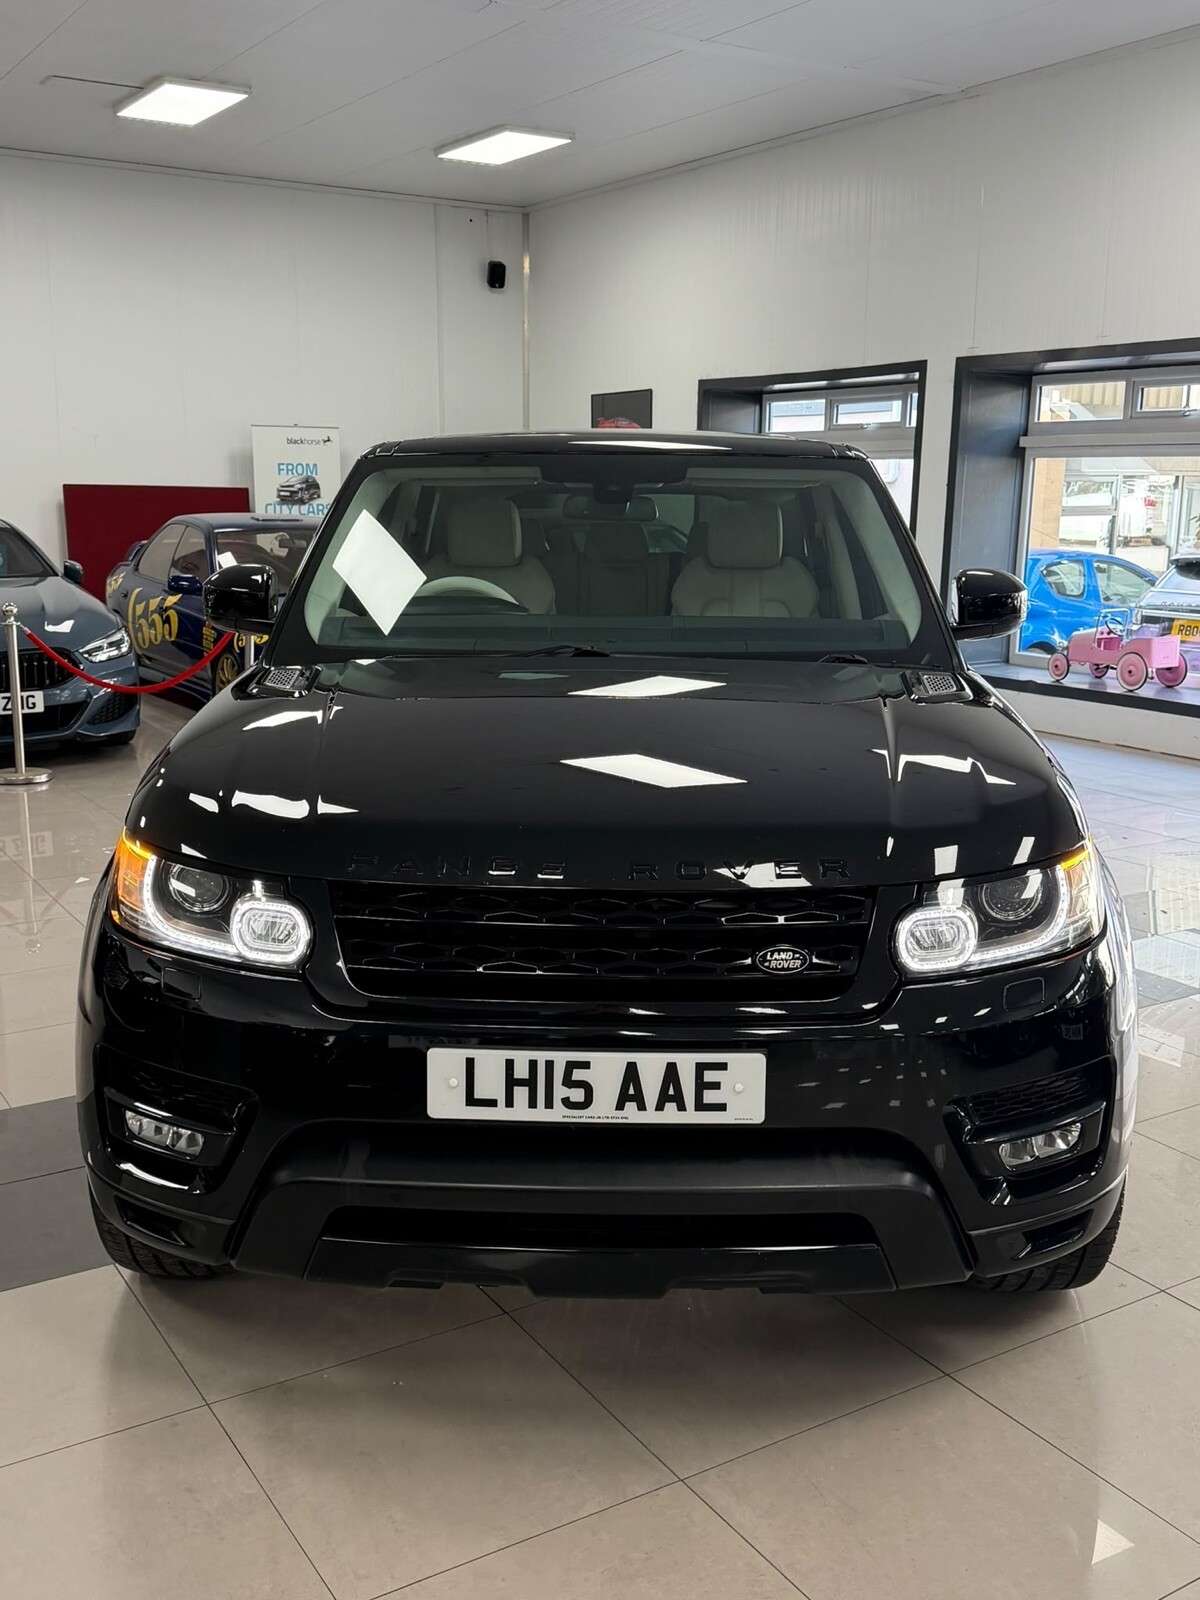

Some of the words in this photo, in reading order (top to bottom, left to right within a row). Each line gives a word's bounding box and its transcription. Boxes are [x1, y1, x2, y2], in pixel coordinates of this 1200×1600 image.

[286, 436, 321, 445] blackhorse
[277, 462, 318, 476] FROM
[264, 502, 295, 515] CITY
[627, 858, 853, 882] ROVER
[766, 951, 793, 960] LAND
[769, 959, 802, 969] ROVER
[465, 1057, 594, 1110] LH15
[614, 1061, 729, 1112] AAE
